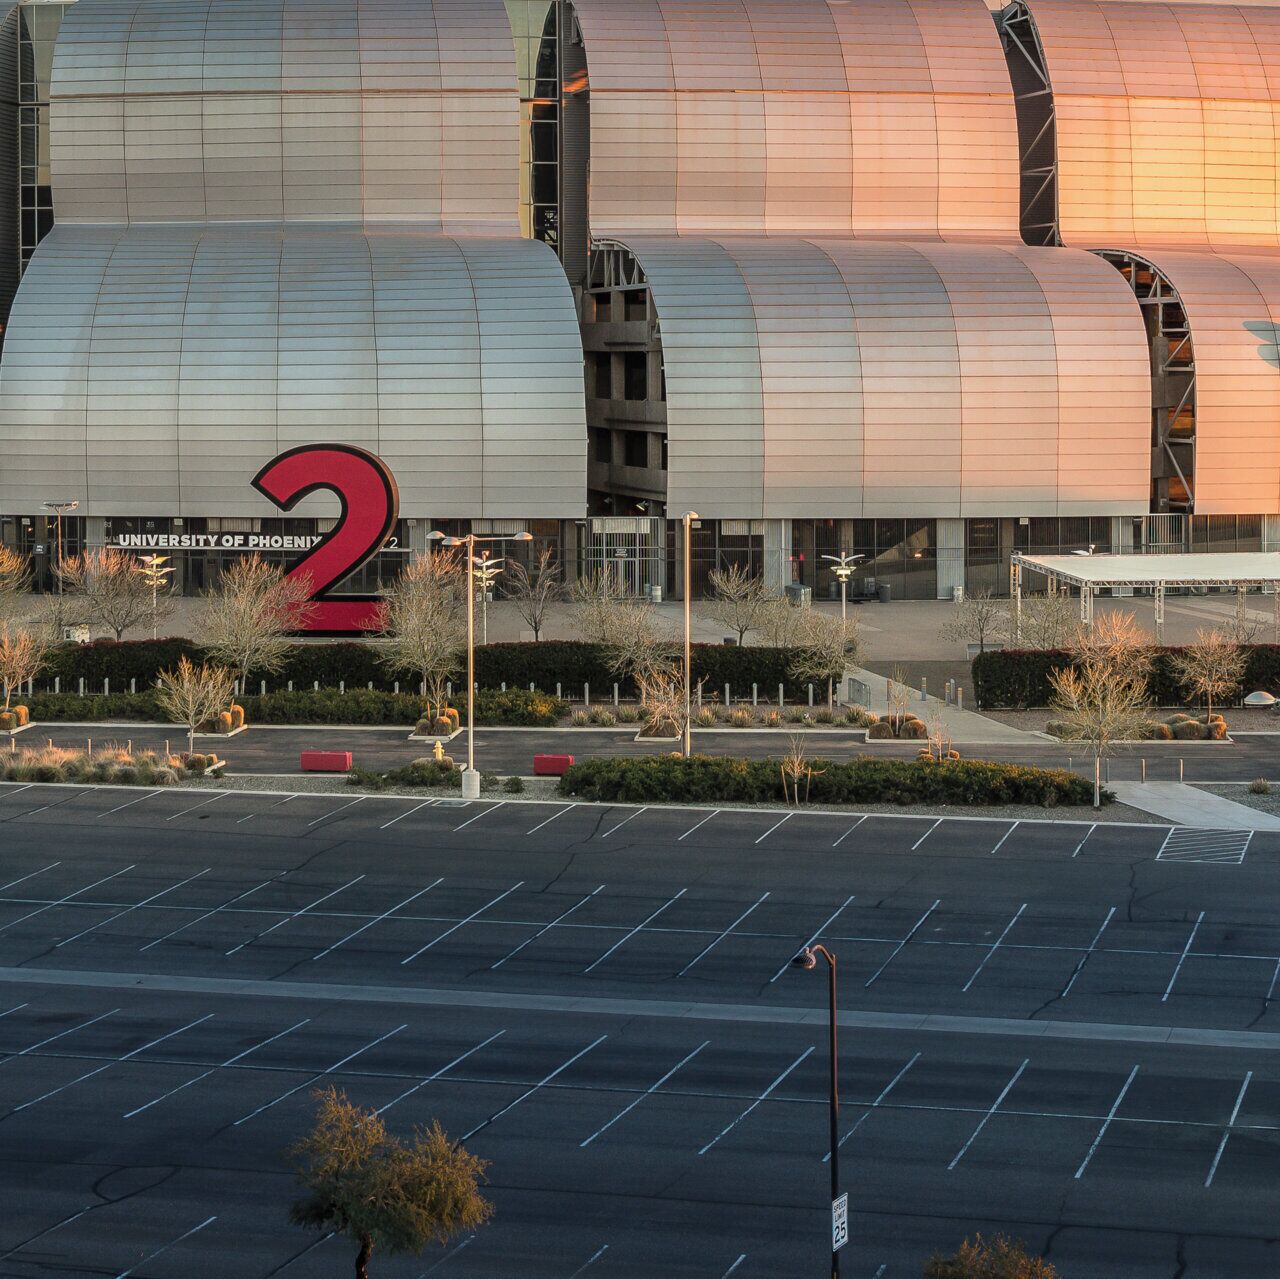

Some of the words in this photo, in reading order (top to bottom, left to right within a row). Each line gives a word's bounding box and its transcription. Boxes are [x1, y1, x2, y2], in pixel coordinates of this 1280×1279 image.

[119, 534, 218, 548] UNIVERSITY
[221, 534, 244, 547] OF
[389, 536, 398, 549] 2
[250, 443, 400, 637] 2
[835, 1220, 847, 1245] 25
